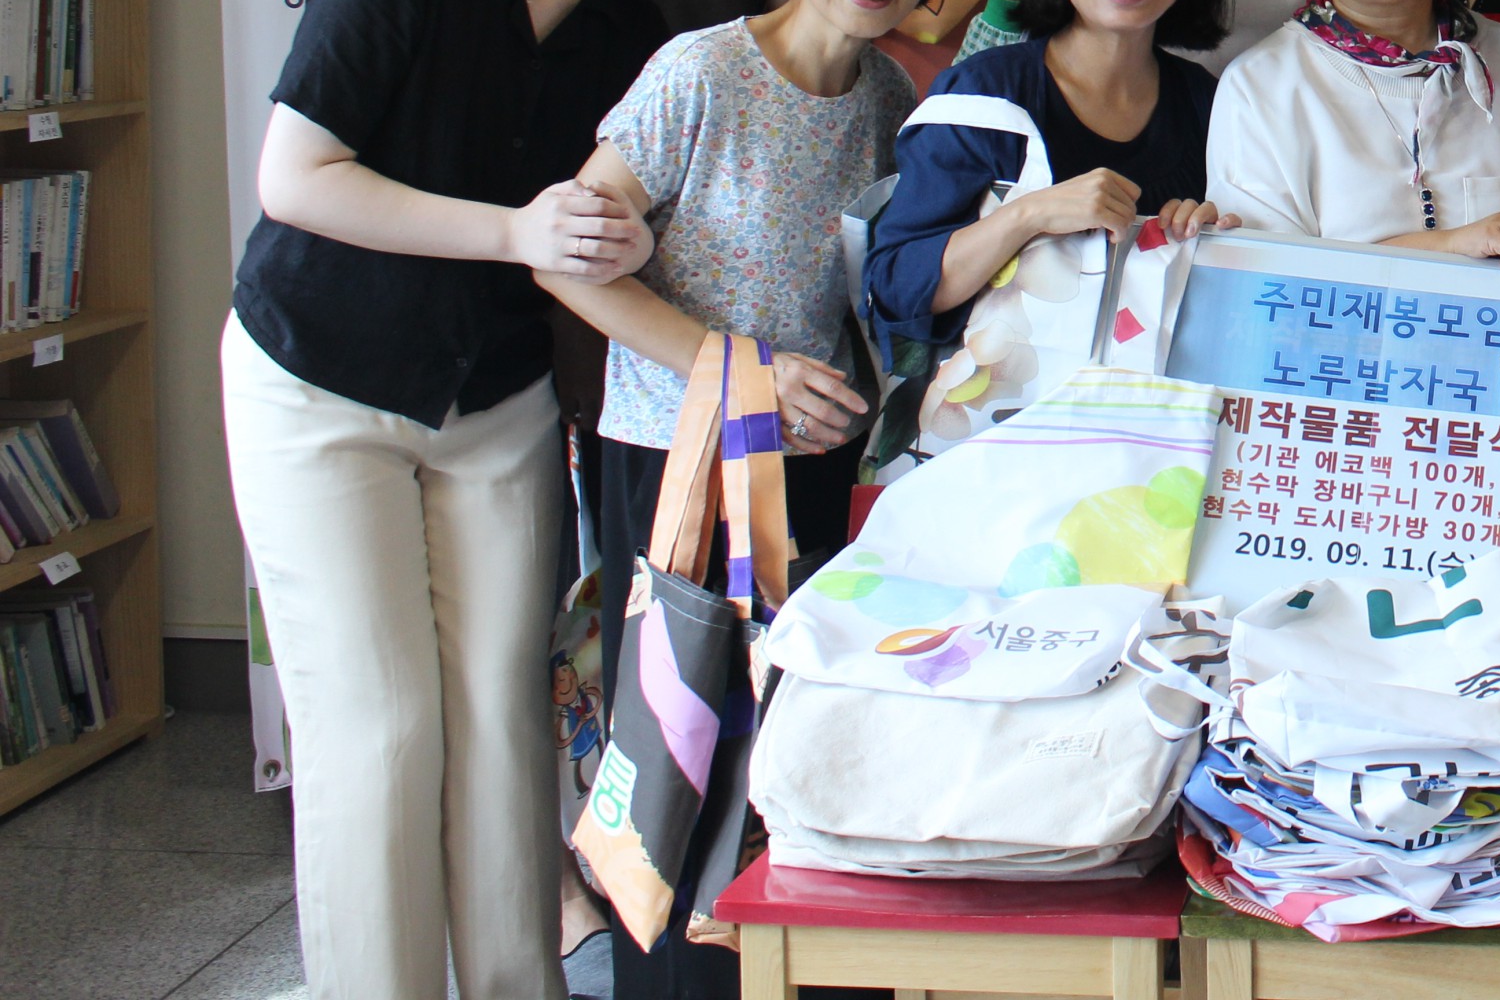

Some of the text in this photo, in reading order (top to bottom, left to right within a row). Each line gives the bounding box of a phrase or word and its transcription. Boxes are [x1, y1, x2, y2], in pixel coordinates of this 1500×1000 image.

[1263, 351, 1488, 412] 노루발자국
[1217, 397, 1381, 448] 제작물품
[1236, 441, 1494, 489] (기관 에코백 100개,
[1221, 468, 1299, 498] 현수막
[1313, 479, 1418, 510] 장바구니
[1203, 495, 1280, 525] 현수막
[1293, 506, 1428, 540] 도시락가방
[1235, 532, 1313, 562] 2019.
[1326, 541, 1368, 567] 09.
[975, 621, 1100, 652] 서울중구
